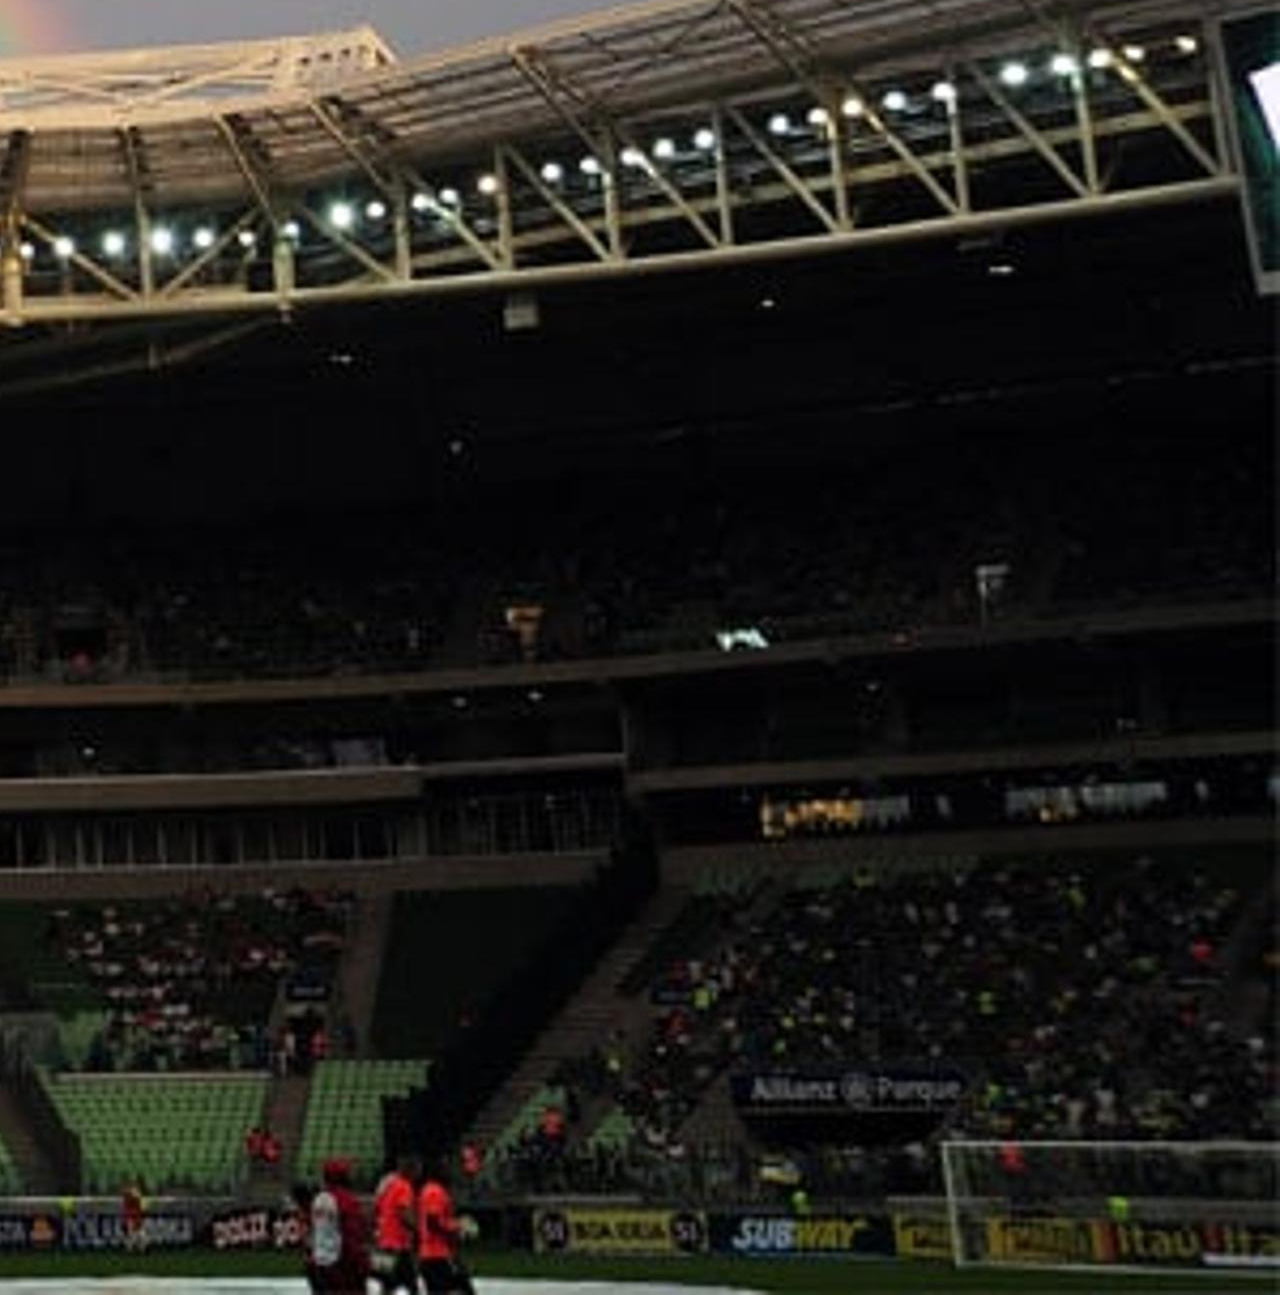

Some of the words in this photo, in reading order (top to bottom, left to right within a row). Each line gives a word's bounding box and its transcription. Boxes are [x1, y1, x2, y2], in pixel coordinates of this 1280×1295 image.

[751, 1075, 838, 1101] Allianz
[878, 1076, 962, 1109] Parque
[731, 1217, 868, 1250] SUBWAY
